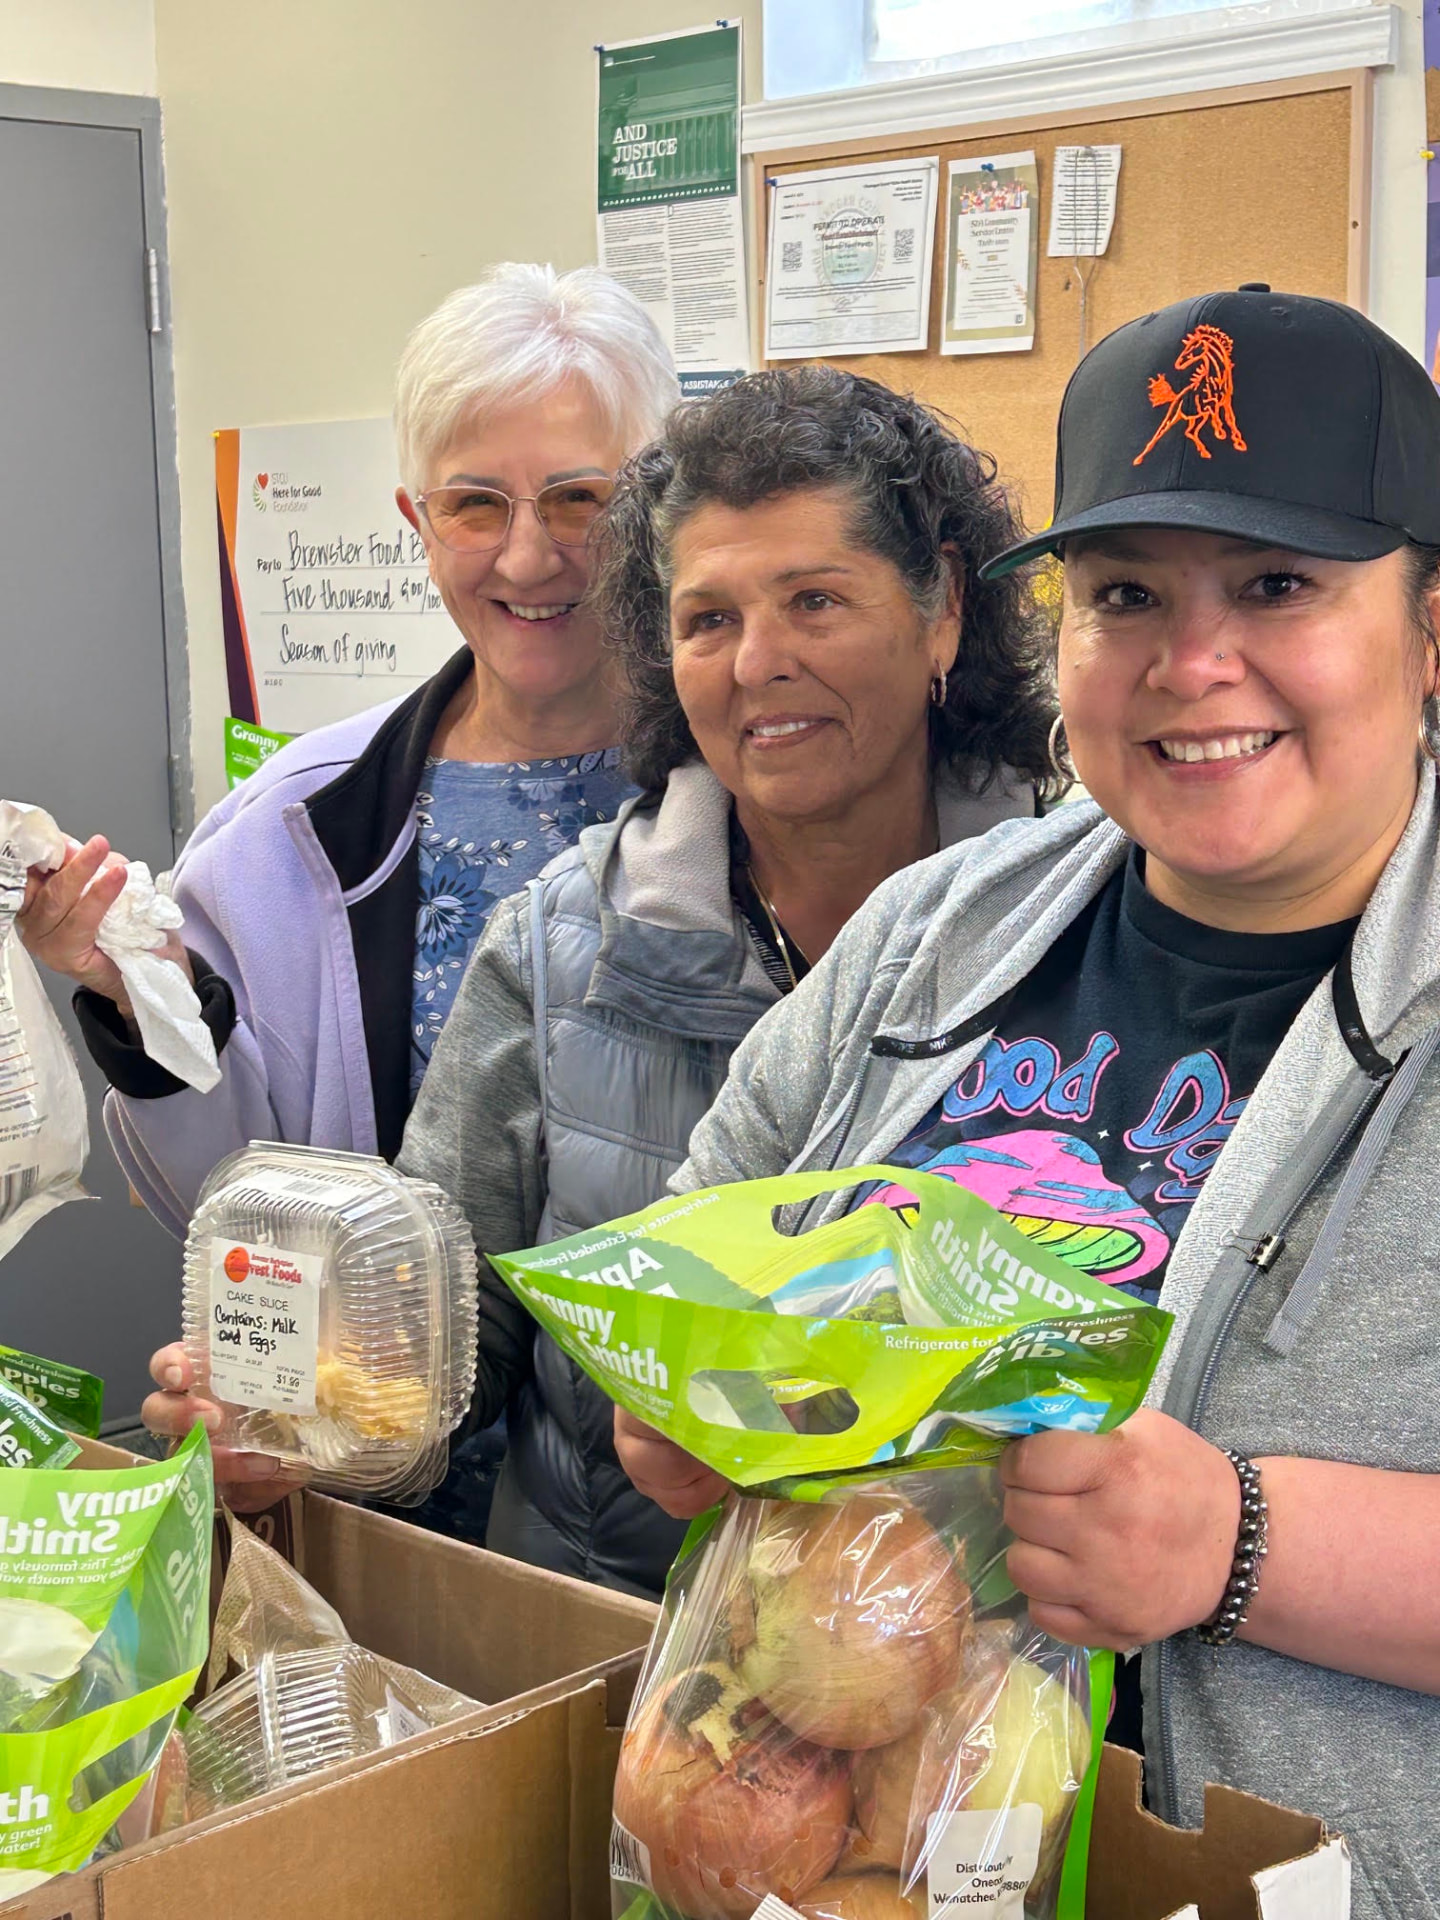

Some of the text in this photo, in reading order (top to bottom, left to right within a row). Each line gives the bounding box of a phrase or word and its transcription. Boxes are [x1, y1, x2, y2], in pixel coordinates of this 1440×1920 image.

[612, 123, 648, 144] AND
[612, 137, 678, 164] JUSTICE
[625, 160, 657, 181] ALL
[272, 487, 290, 498] Here
[302, 485, 322, 497] Good
[288, 530, 364, 571] Brewster
[368, 529, 405, 566] Food
[282, 576, 317, 613] Five
[319, 577, 395, 611] thousand
[279, 623, 331, 664] Season
[355, 636, 397, 676] giving
[231, 724, 279, 752] Granny
[227, 1290, 290, 1312] CAKE SLICE
[214, 1304, 300, 1335] Contains: Milk
[885, 1335, 969, 1352] Refrigerate
[972, 1337, 993, 1349] for
[1065, 1313, 1135, 1328] Freshness
[218, 1328, 242, 1346] and
[249, 1331, 277, 1356] Eggs
[577, 1329, 669, 1391] Smith
[0, 1366, 80, 1399] pples
[10, 1404, 54, 1446] Freshness
[12, 1824, 52, 1840] green
